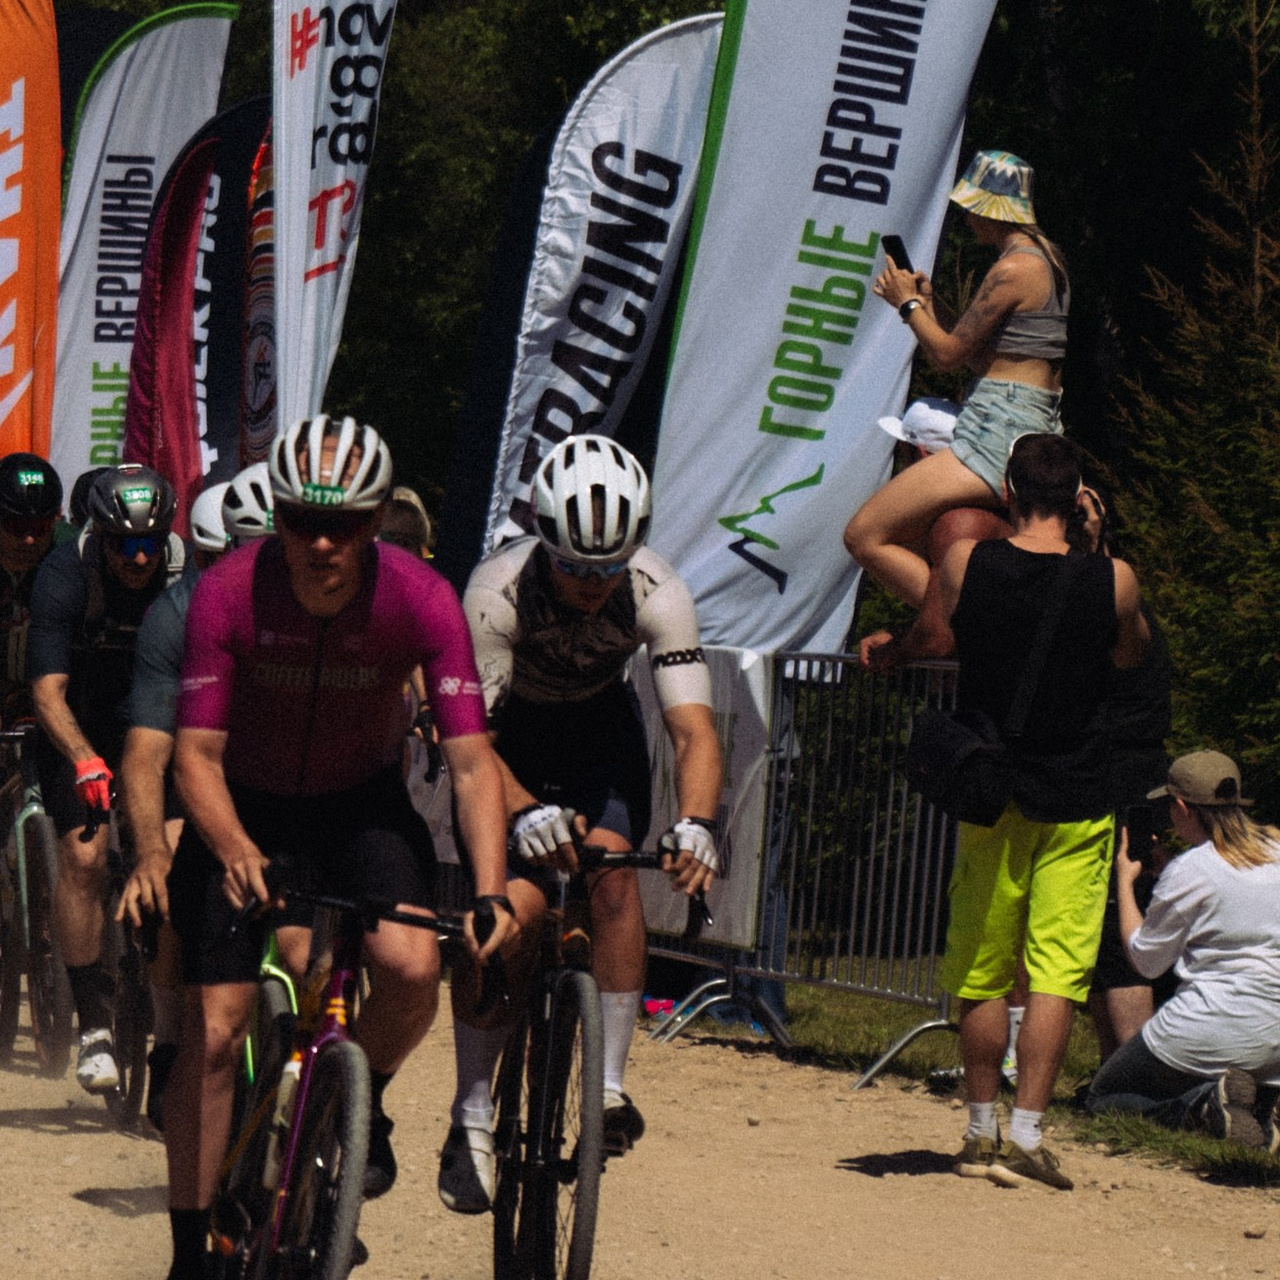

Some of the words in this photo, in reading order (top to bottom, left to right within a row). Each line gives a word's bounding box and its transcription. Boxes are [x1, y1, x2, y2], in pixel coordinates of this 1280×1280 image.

[93, 154, 156, 344] ВЕРШИНЫ
[758, 218, 881, 442] ГОРНЫЕ
[89, 361, 133, 467] РНЫЕ
[303, 487, 344, 504] 3170
